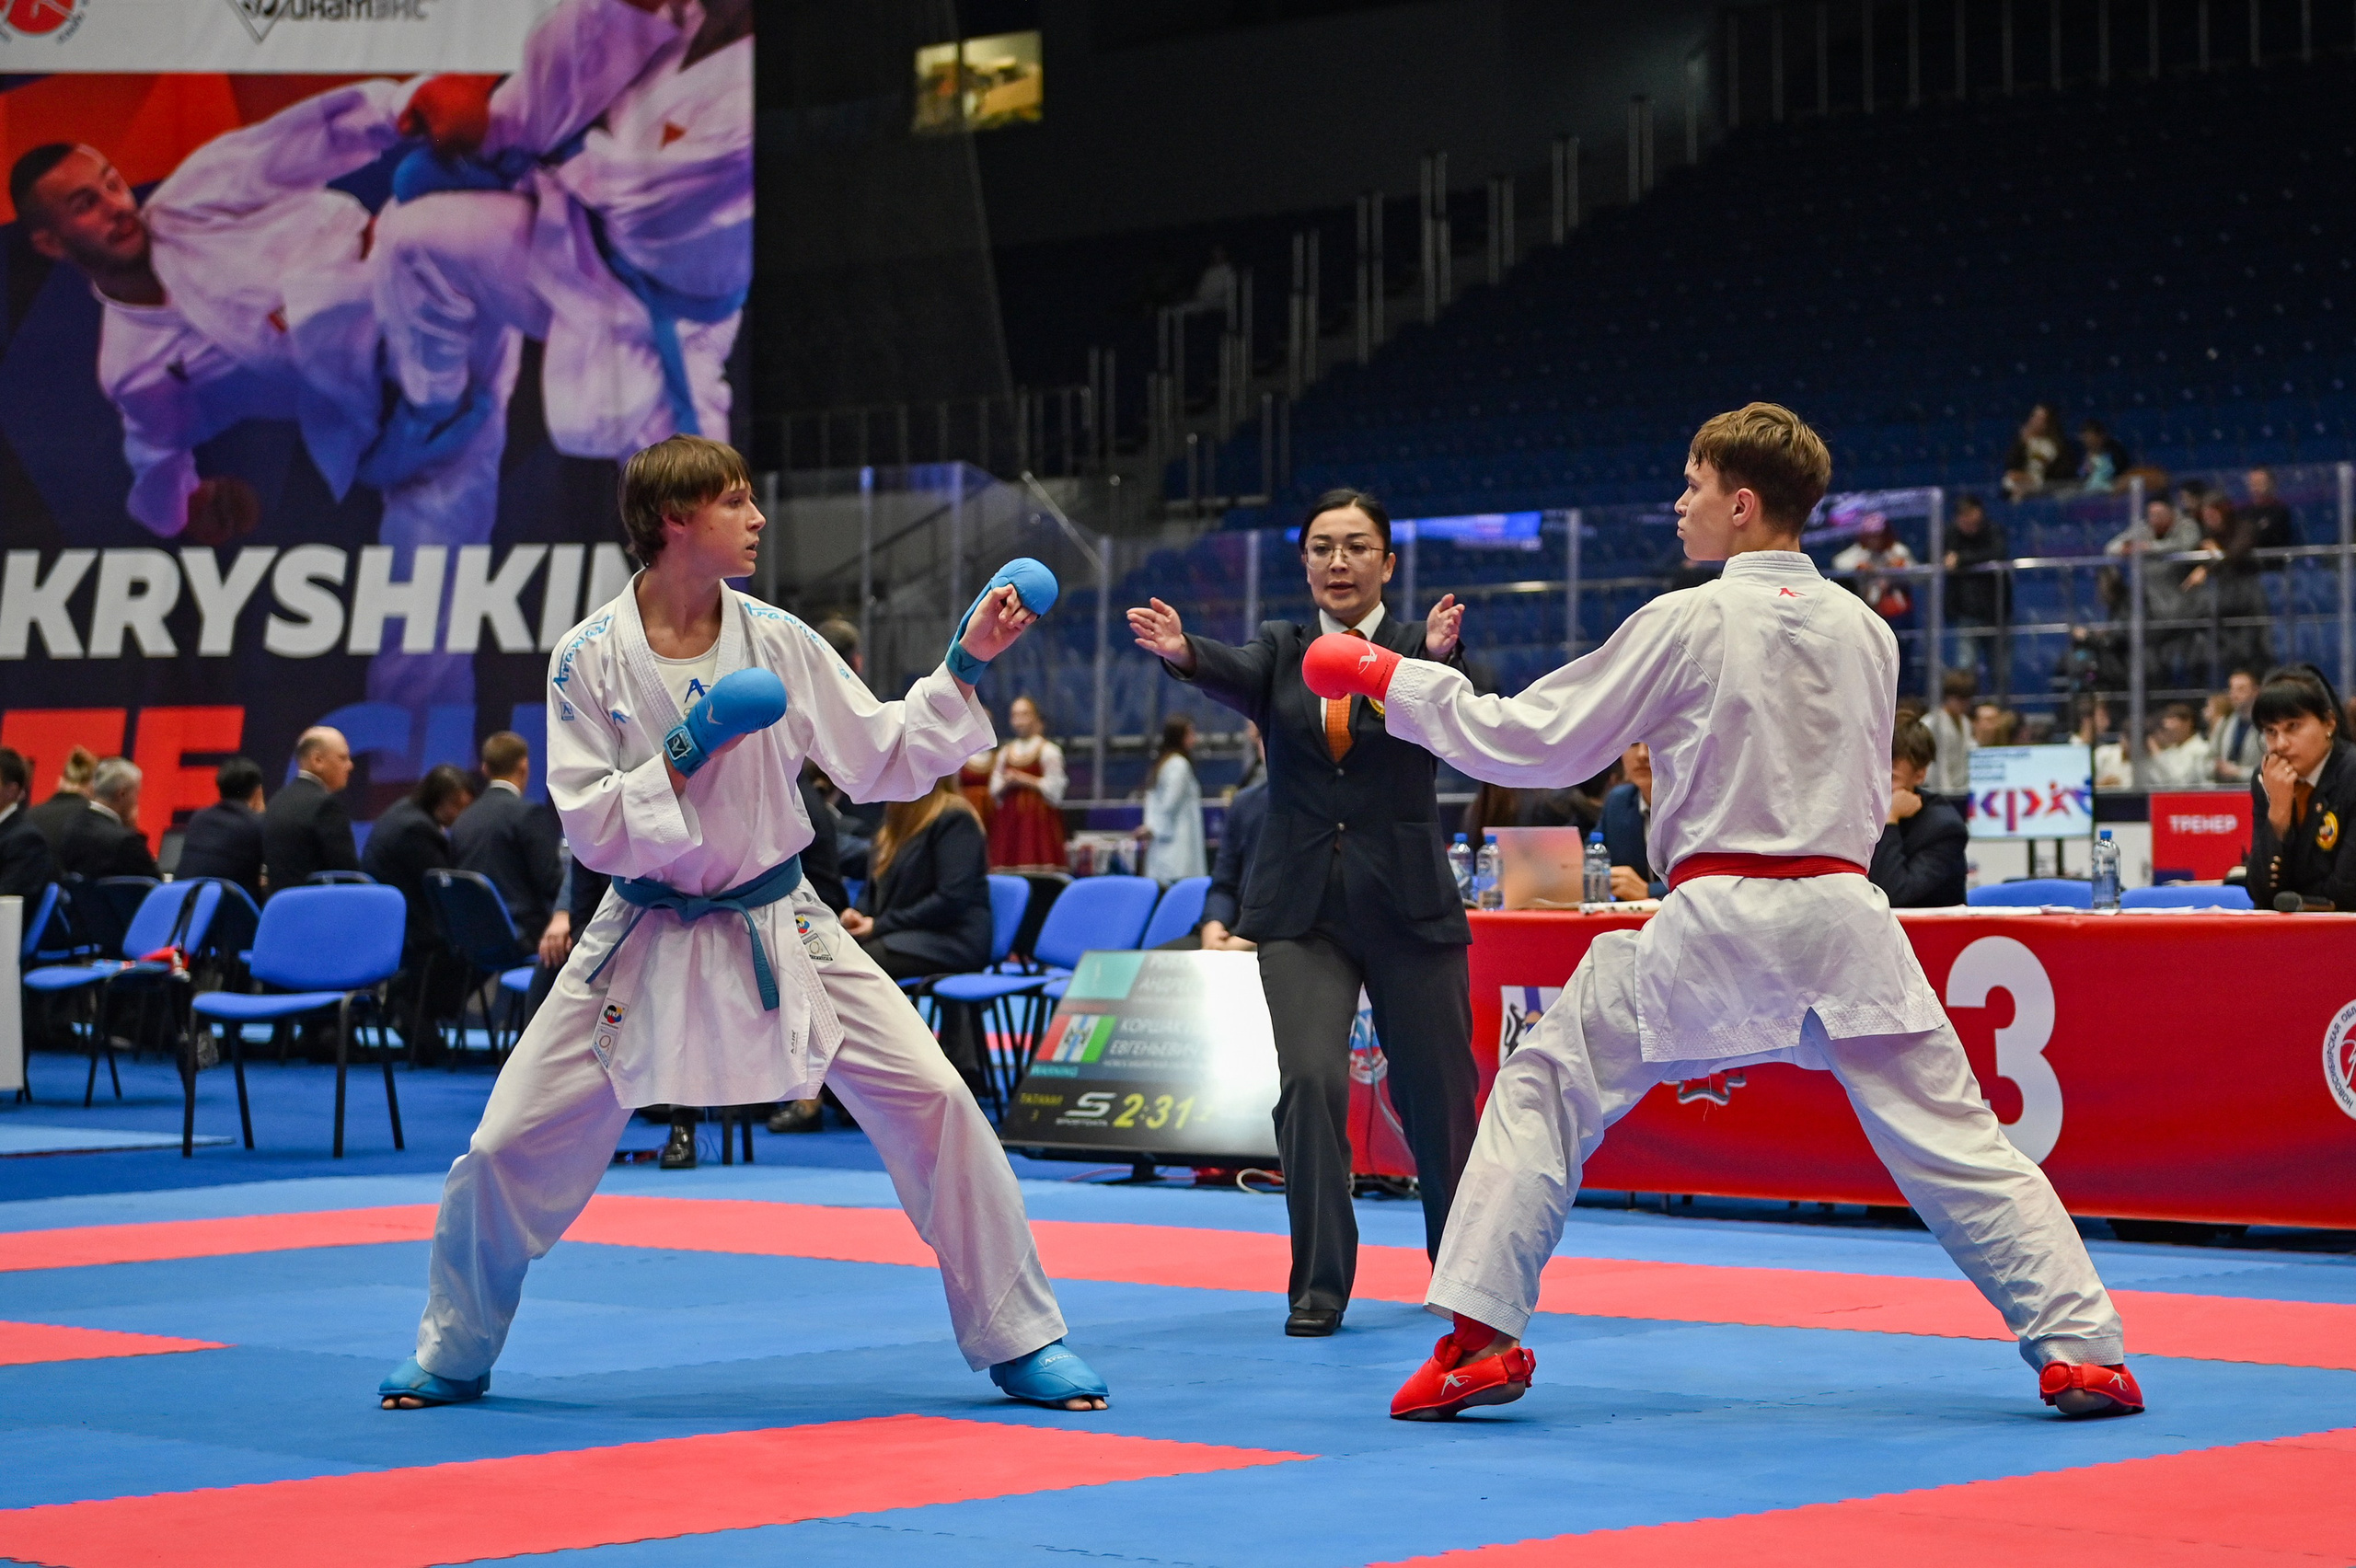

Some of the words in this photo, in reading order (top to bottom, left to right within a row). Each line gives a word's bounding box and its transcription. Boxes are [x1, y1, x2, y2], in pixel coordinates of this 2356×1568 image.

[2168, 814, 2238, 835] ТРЕНЕР
[1946, 936, 2063, 1165] 3
[2327, 1022, 2354, 1110] НОВОСИБИРСКАЯ
